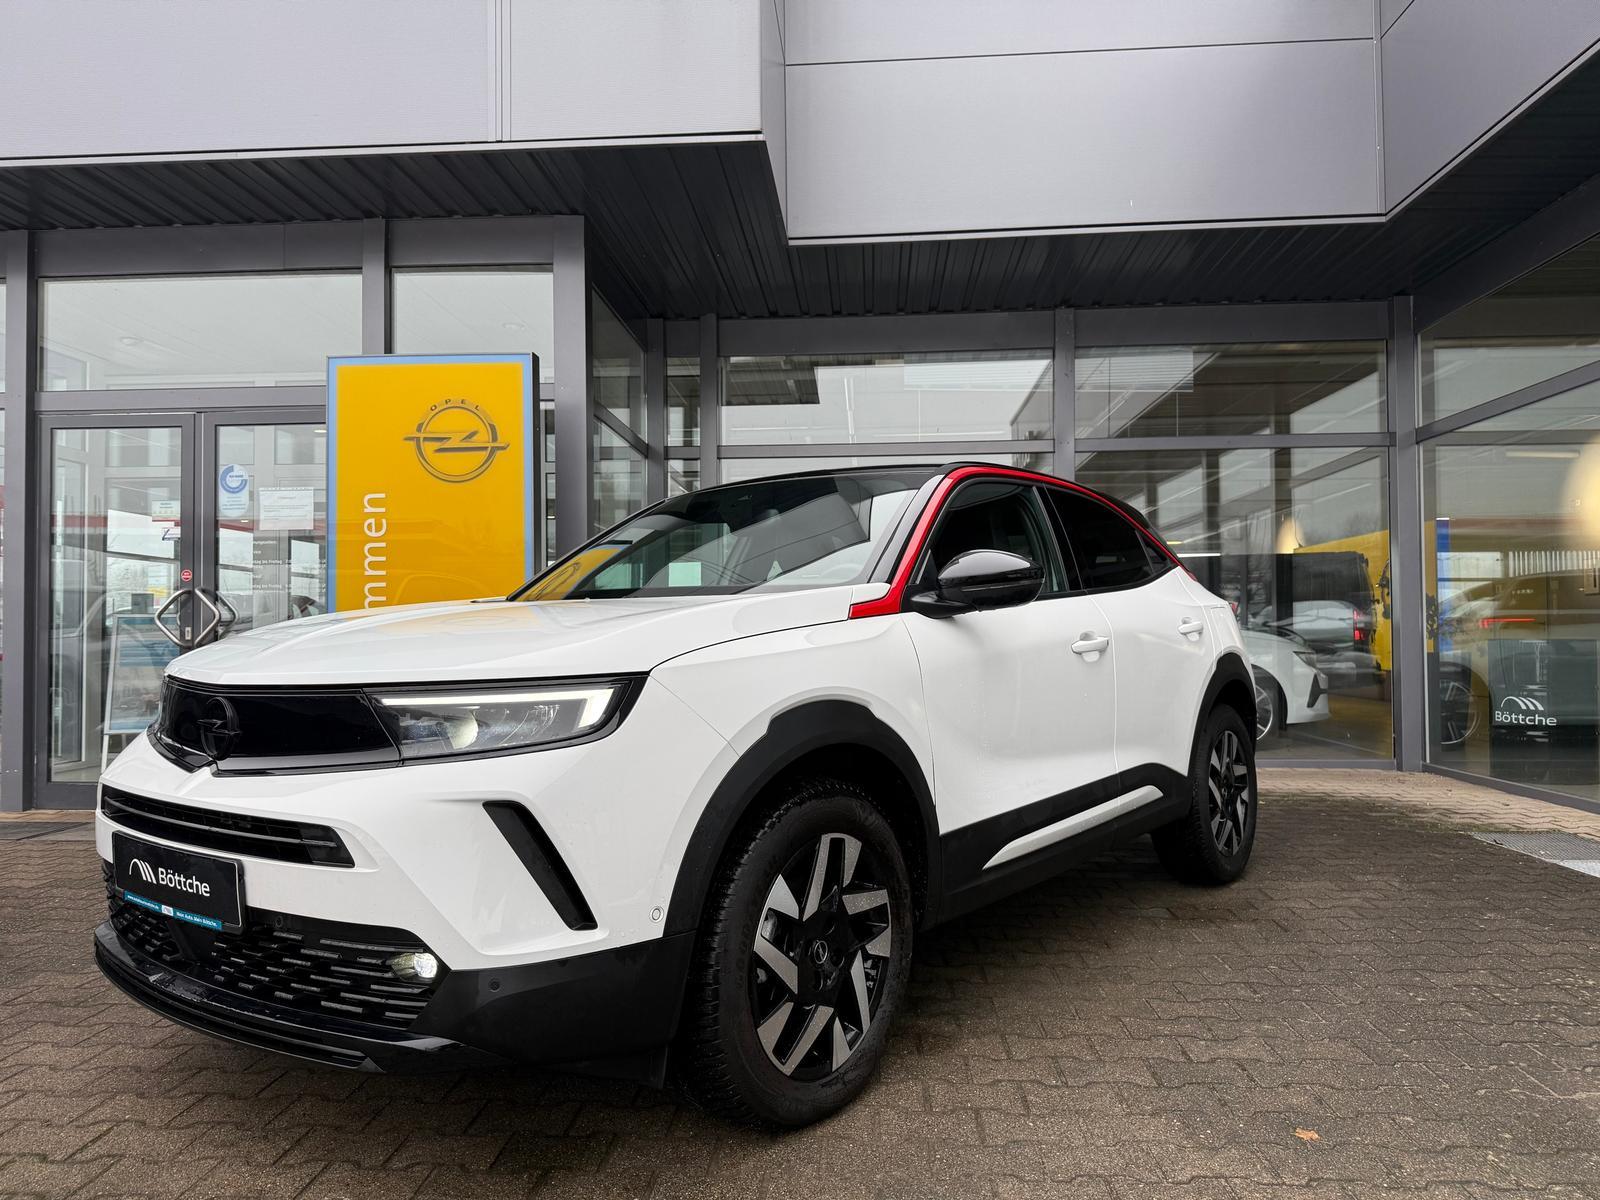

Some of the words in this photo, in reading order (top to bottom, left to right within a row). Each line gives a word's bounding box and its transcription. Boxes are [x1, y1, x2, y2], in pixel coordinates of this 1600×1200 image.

[430, 399, 480, 412] OPEL
[1495, 711, 1557, 726] Böttche
[158, 867, 211, 897] Böttche
